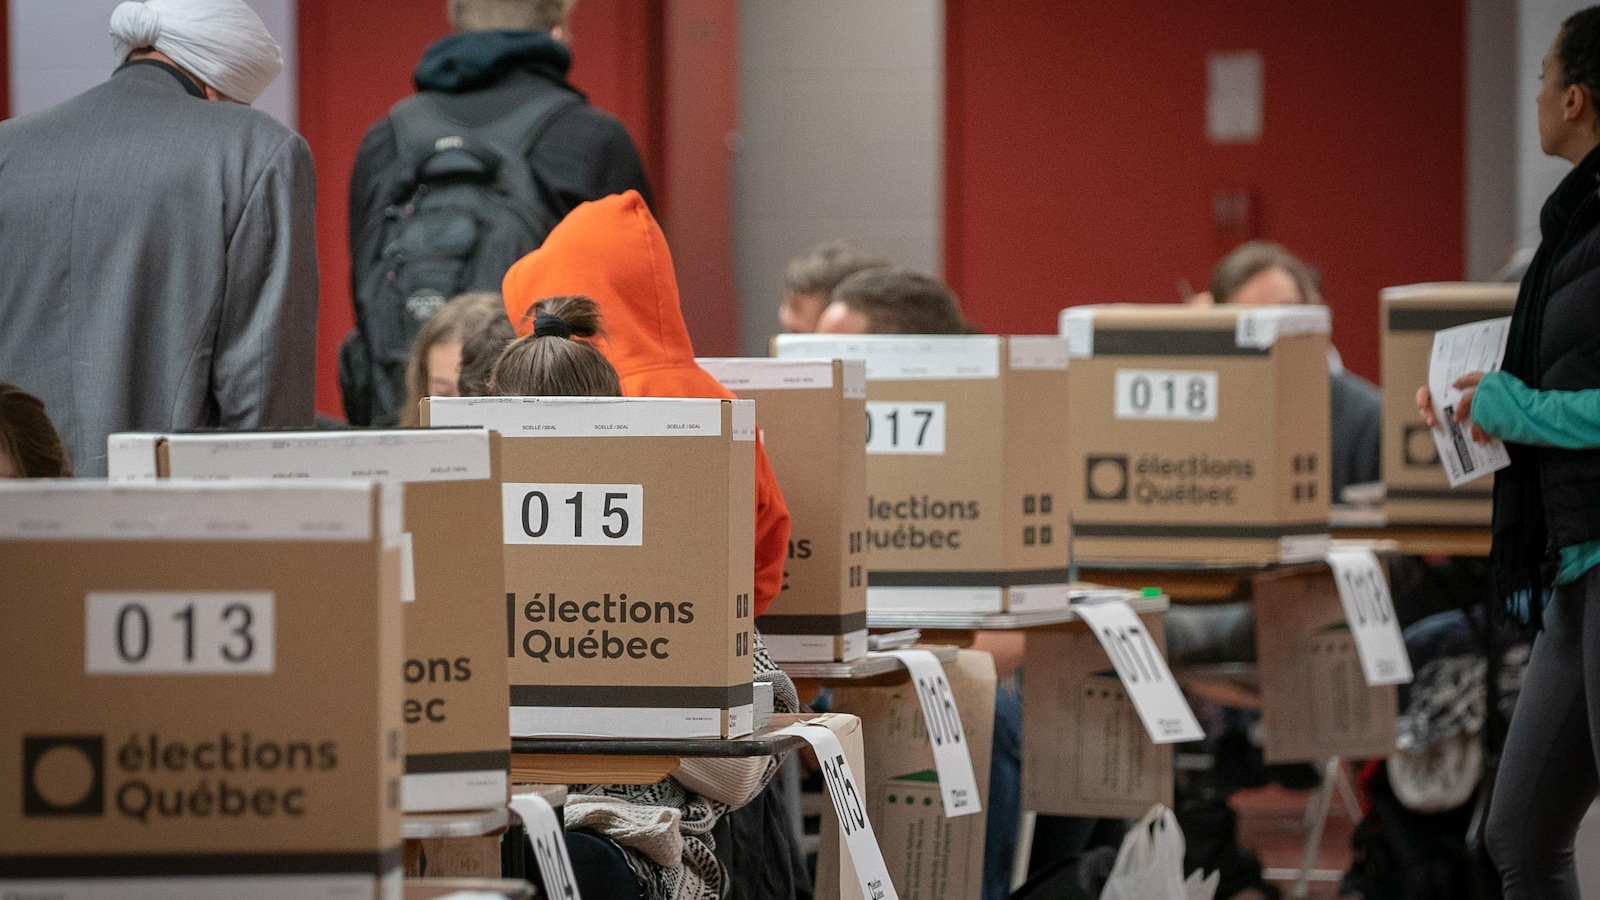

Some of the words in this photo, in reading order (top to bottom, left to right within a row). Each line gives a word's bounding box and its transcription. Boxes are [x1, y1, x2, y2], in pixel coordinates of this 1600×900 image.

[1130, 376, 1208, 414] 018
[1134, 454, 1255, 480] élections
[868, 495, 981, 521] lections
[1134, 480, 1238, 507] Québec
[521, 490, 630, 539] 015
[866, 525, 961, 551] uébec
[523, 592, 696, 624] élections
[114, 602, 256, 665] 013
[522, 628, 671, 664] Québec
[1103, 625, 1162, 684] 017
[919, 676, 961, 746] 016
[115, 730, 338, 774] élections
[113, 777, 306, 822] Québec
[823, 754, 865, 836] 015
